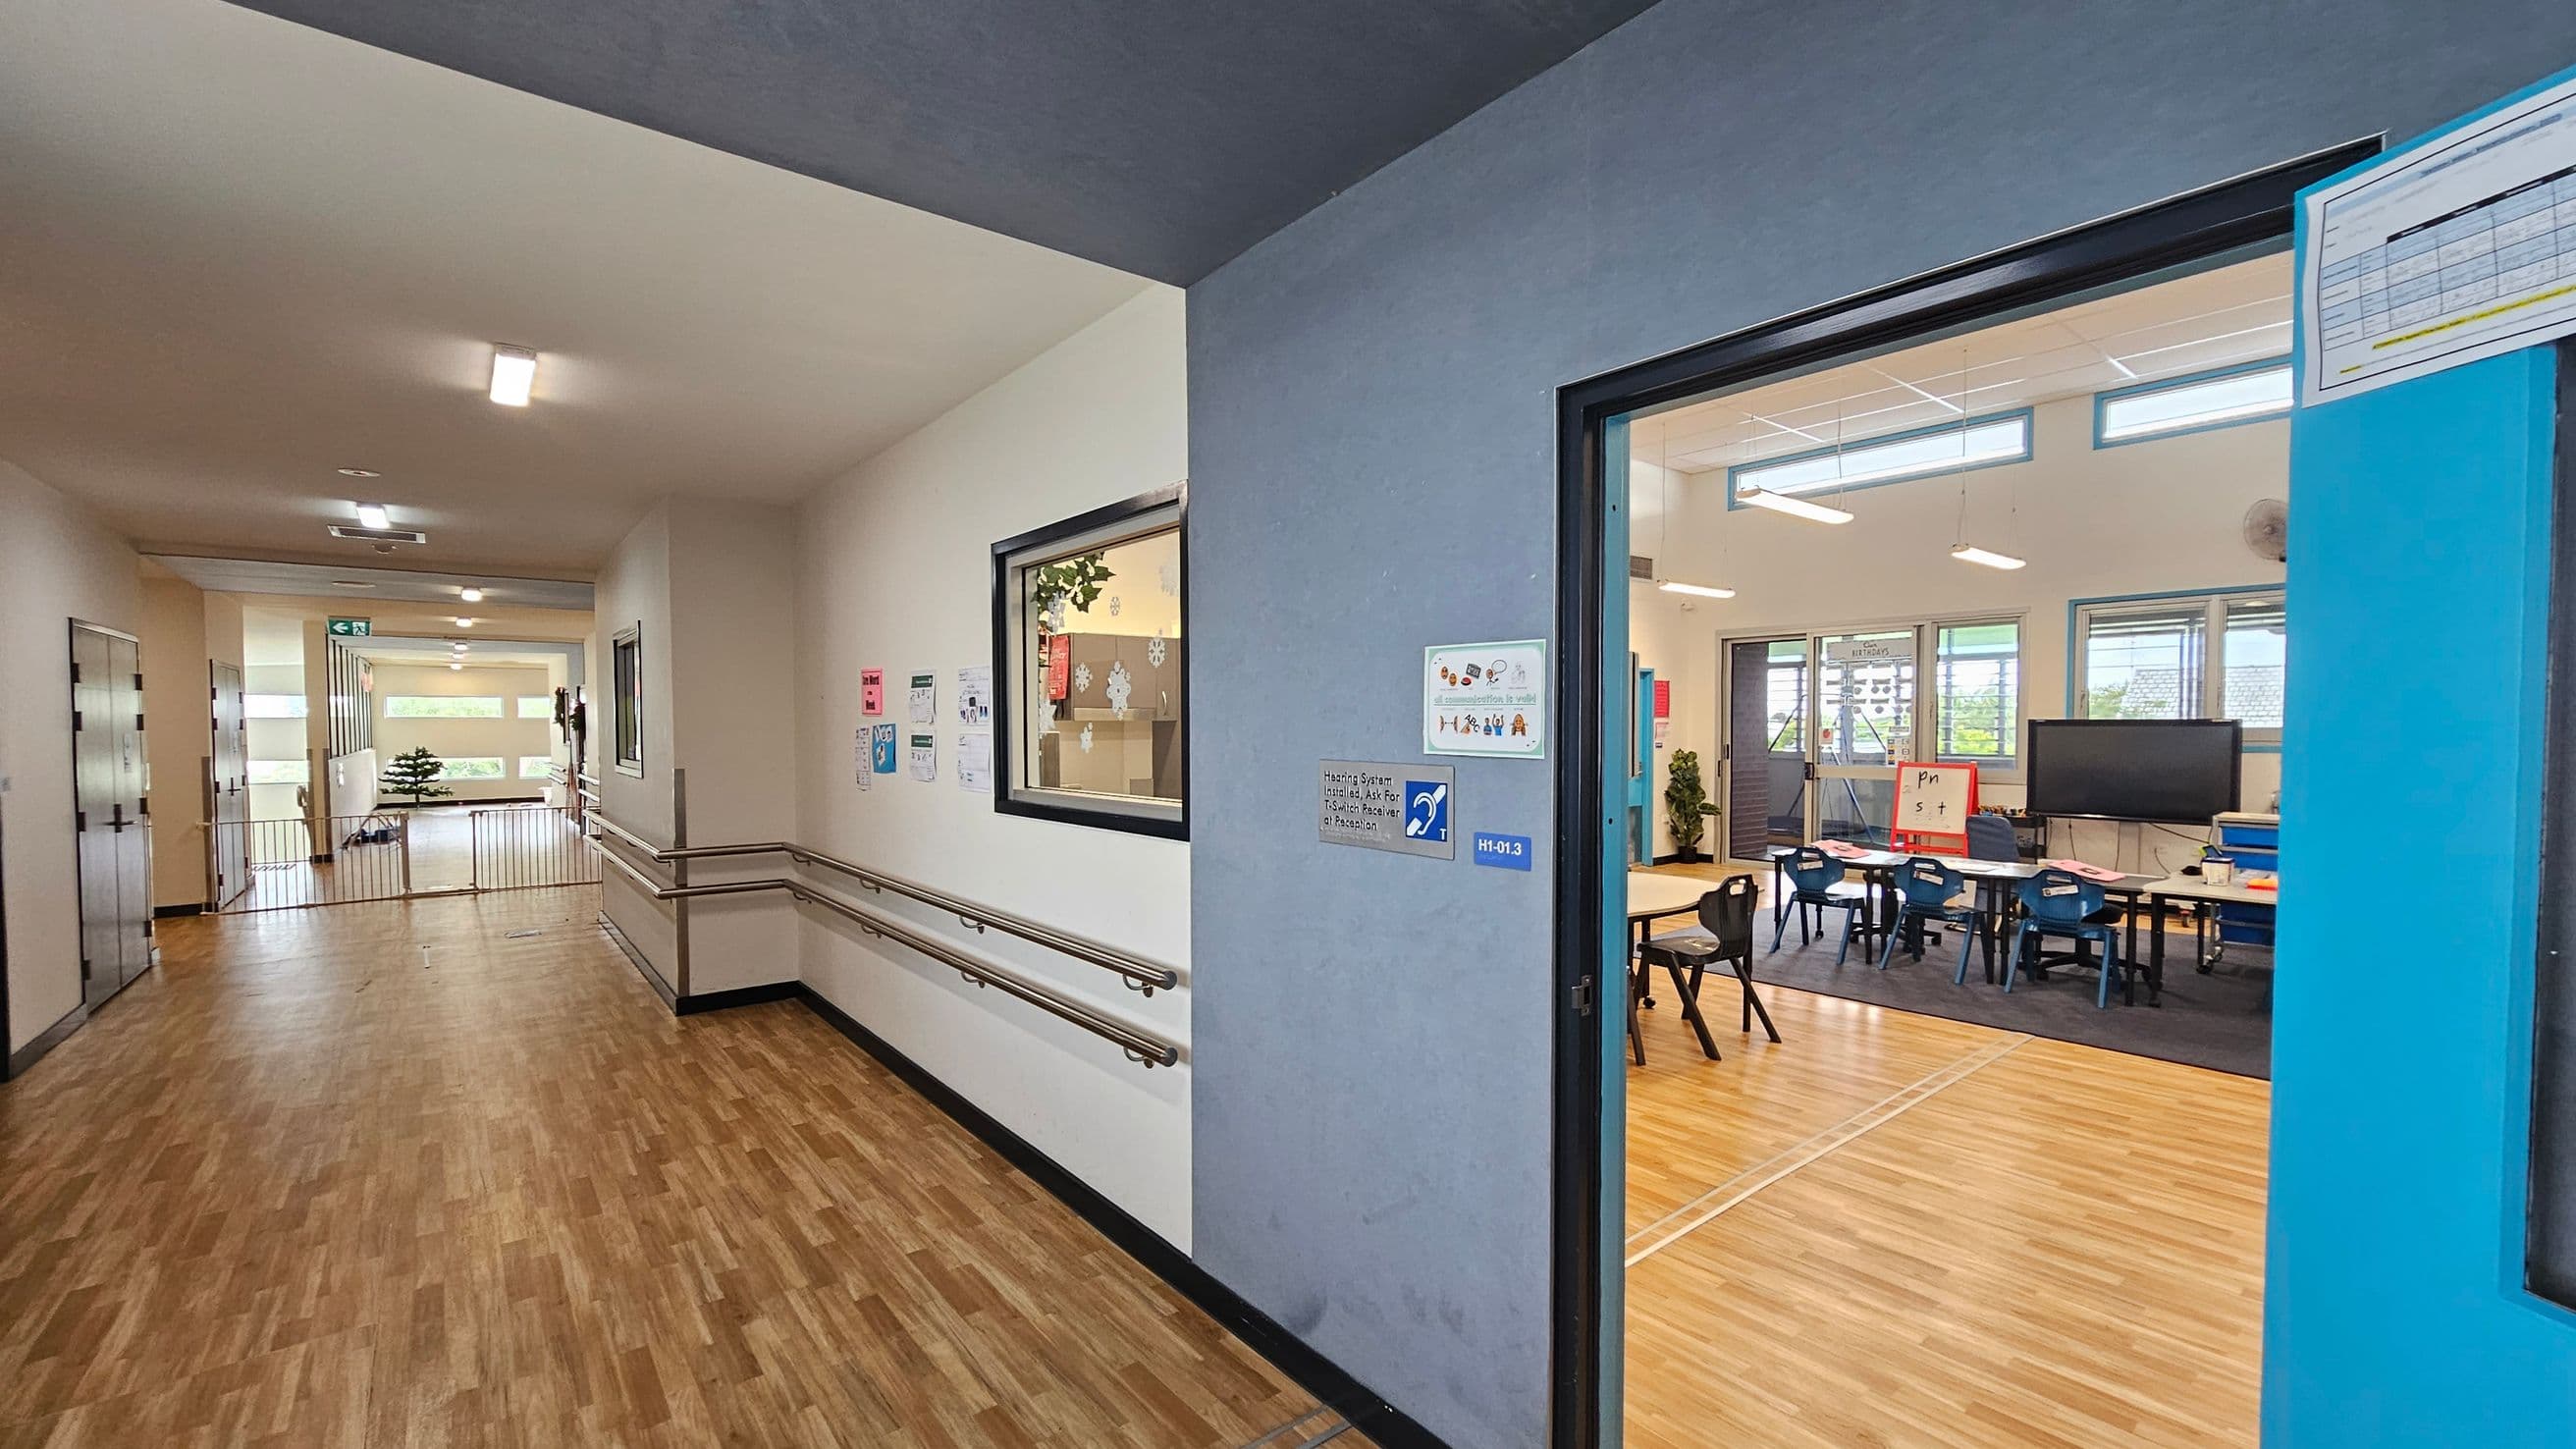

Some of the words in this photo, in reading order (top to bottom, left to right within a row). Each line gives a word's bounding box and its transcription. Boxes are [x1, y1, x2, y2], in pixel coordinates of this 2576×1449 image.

[1852, 648, 1890, 657] BIRTHDAYS
[1517, 693, 1536, 704] valid
[1464, 714, 1480, 733] ABC
[1323, 771, 1359, 785] Hearing
[1361, 773, 1392, 786] System
[1324, 785, 1364, 800] Installed,
[1366, 790, 1382, 801] Ask
[1384, 792, 1400, 803] For
[1324, 800, 1360, 814] T-Switch
[1363, 804, 1400, 818] Receiver
[1323, 817, 1333, 826] at
[1335, 816, 1377, 832] Reception
[1439, 828, 1447, 840] T
[1477, 838, 1522, 856] H1-01.3
